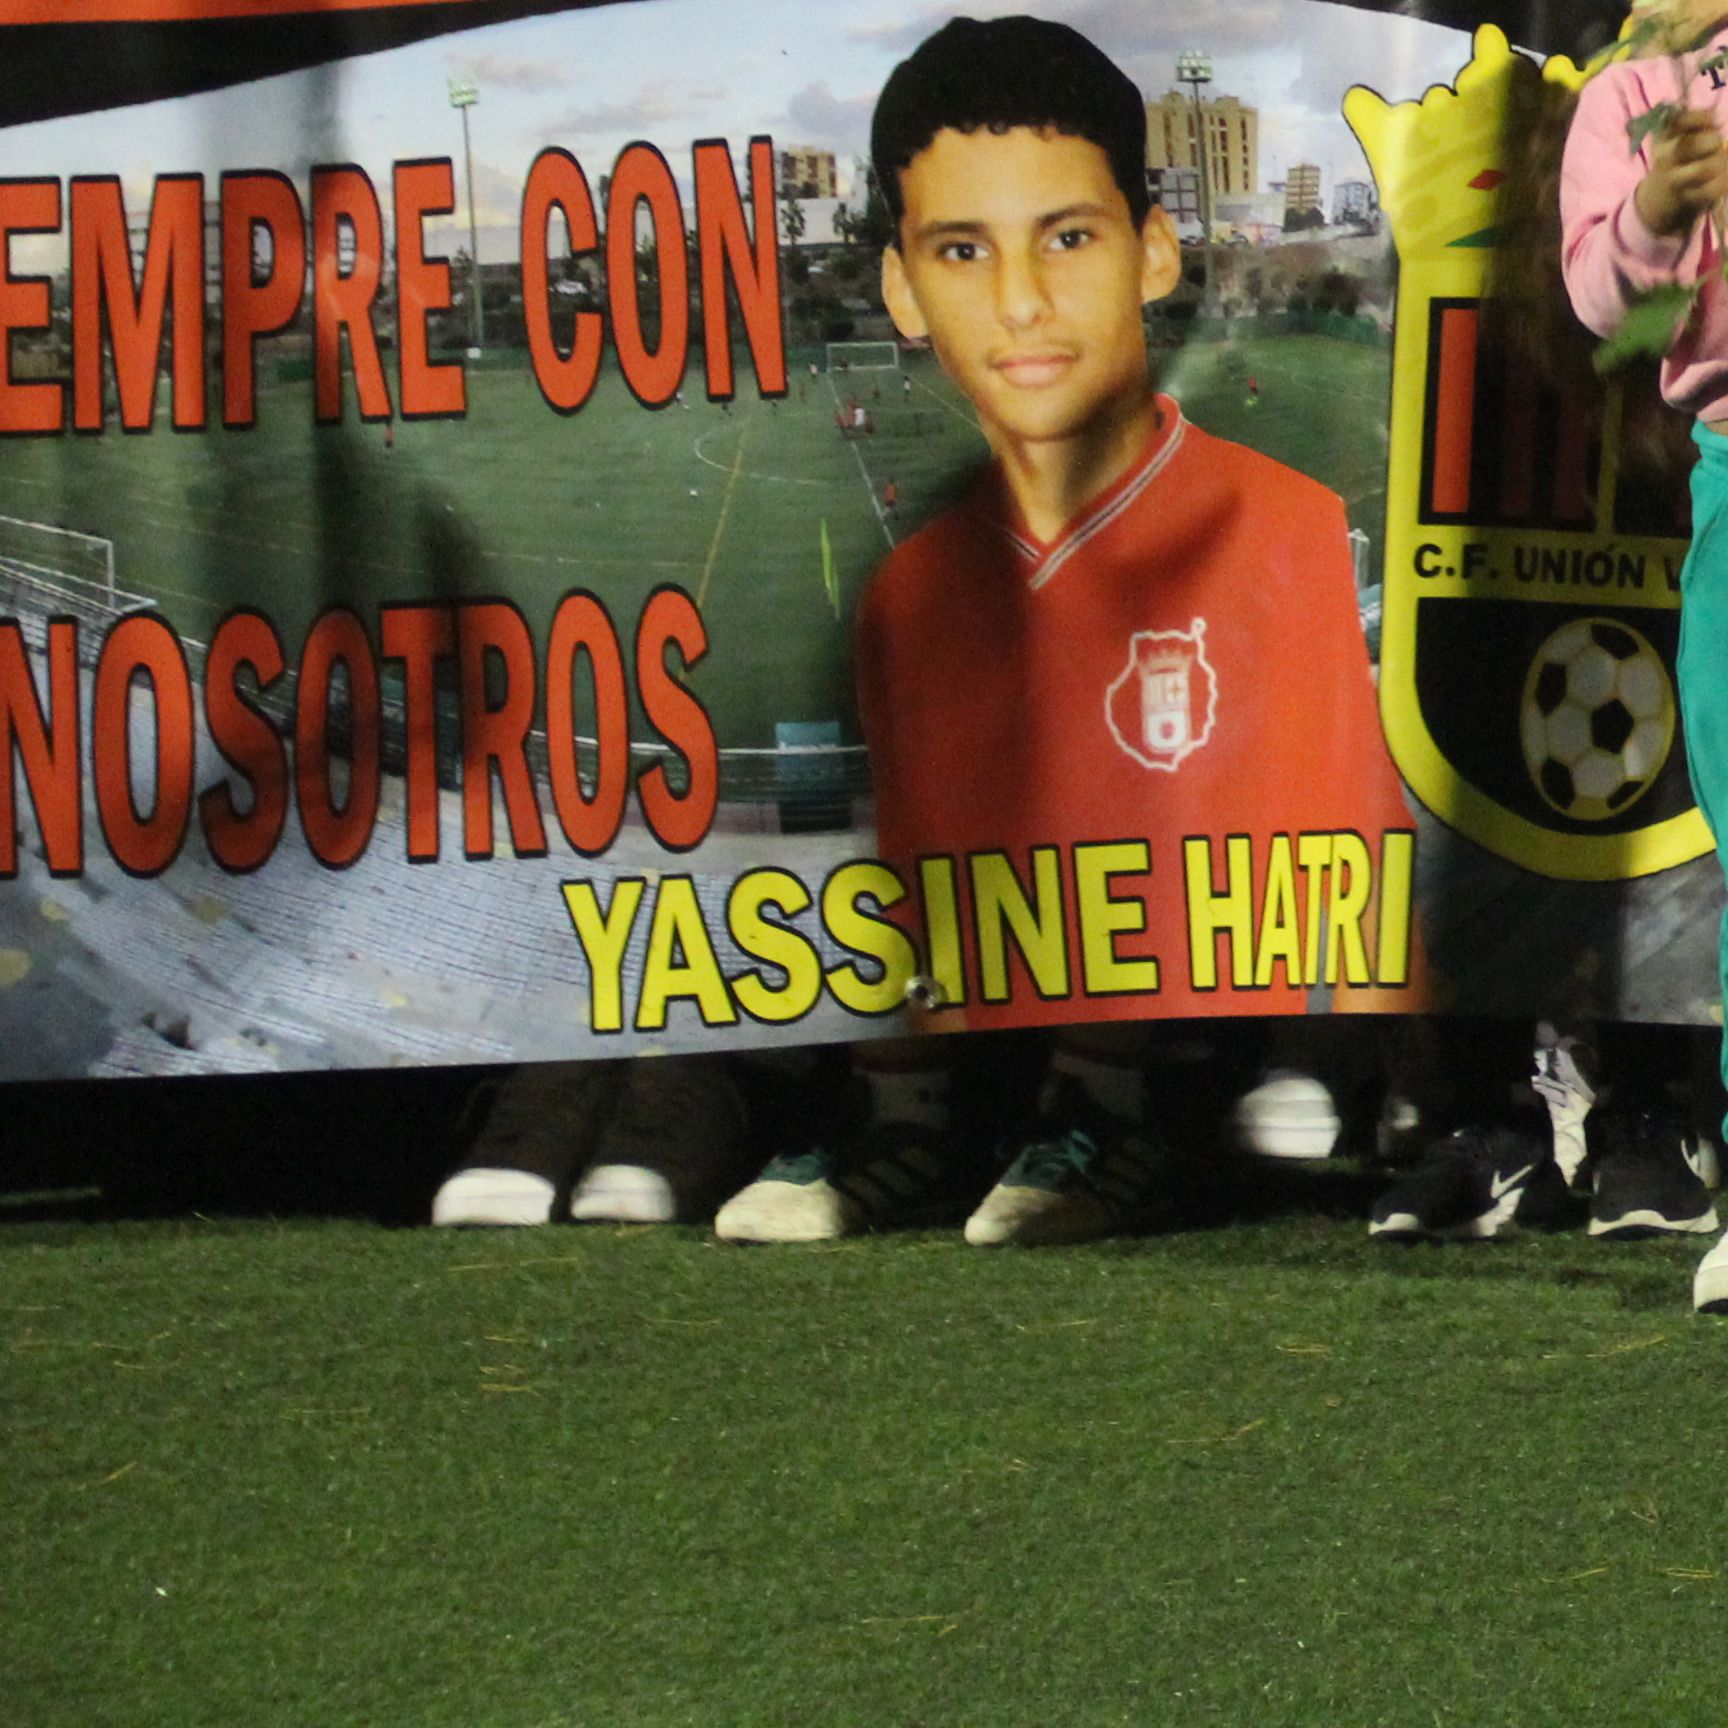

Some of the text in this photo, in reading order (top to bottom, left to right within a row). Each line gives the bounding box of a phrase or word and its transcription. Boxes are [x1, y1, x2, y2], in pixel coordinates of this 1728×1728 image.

[519, 134, 790, 416] CON
[1414, 543, 1498, 579] C.F.
[1513, 543, 1646, 589] UNIÓN
[0, 582, 720, 879] NOSOTROS
[560, 828, 1417, 1035] YASSINE HATRI
